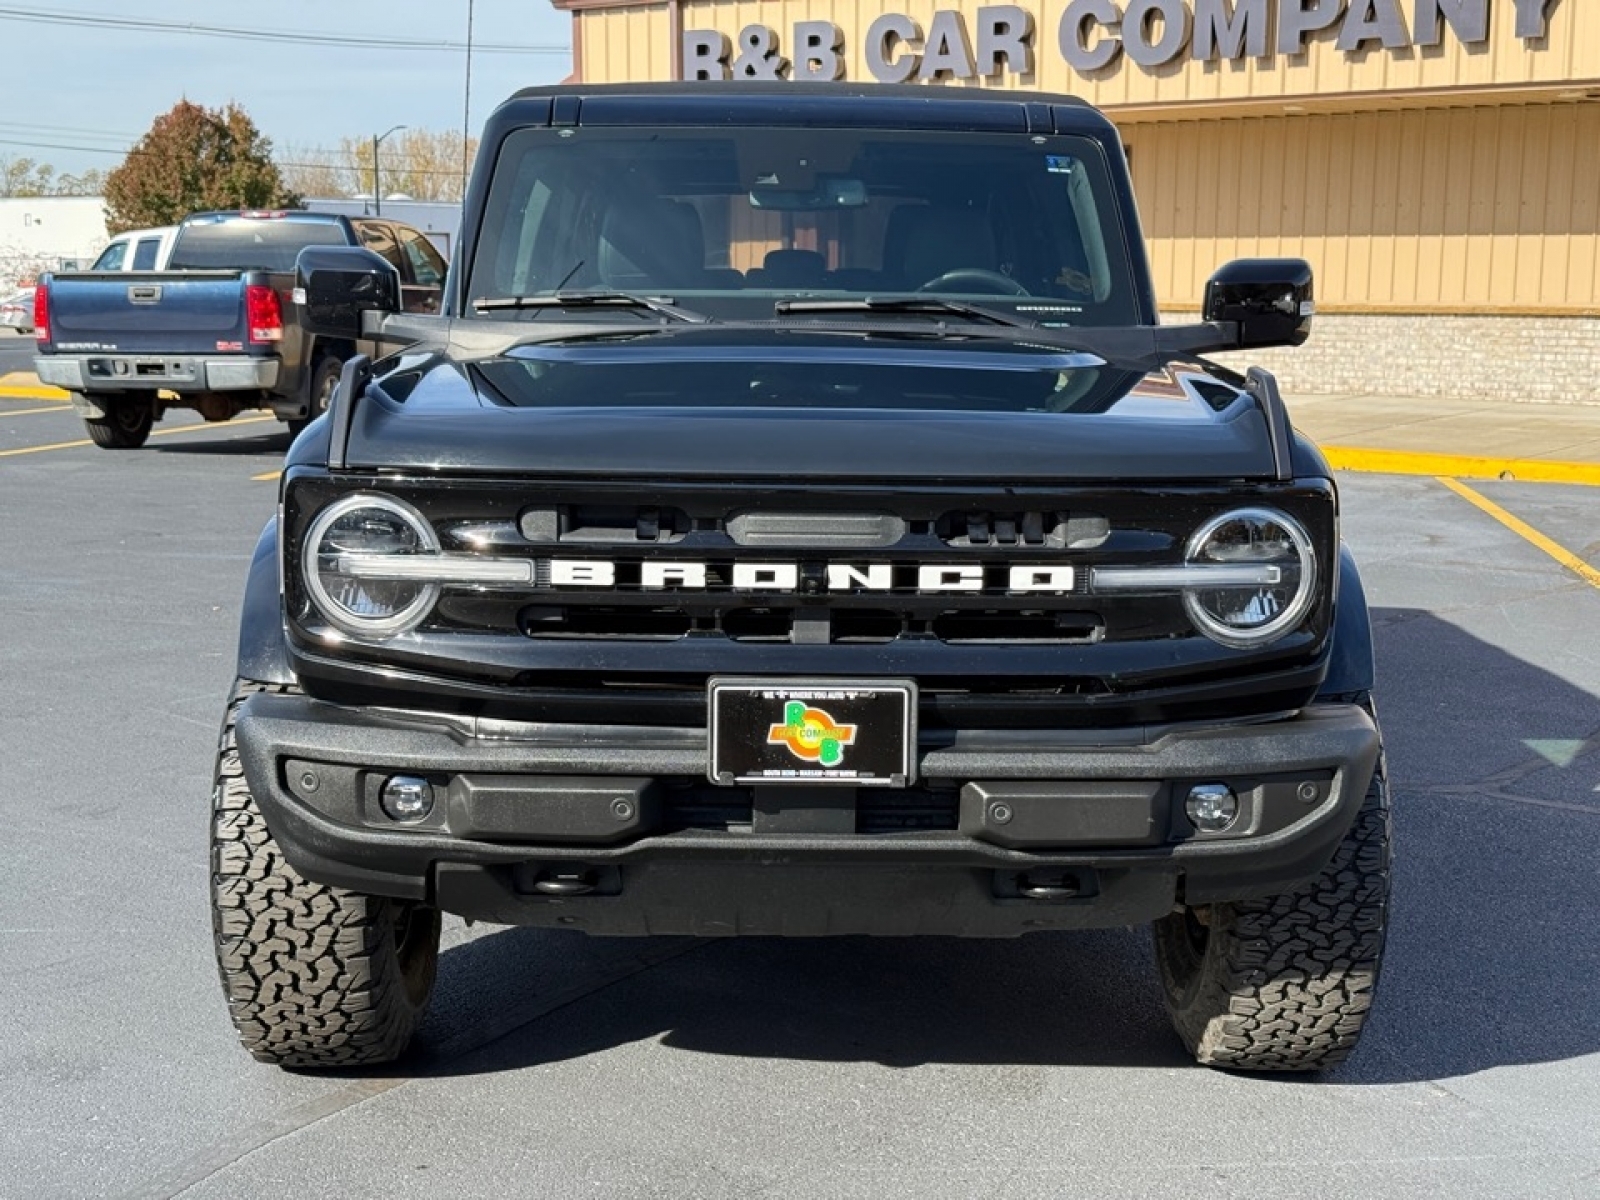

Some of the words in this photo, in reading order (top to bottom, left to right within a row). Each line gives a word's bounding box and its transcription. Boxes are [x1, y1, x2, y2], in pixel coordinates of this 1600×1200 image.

[683, 20, 846, 81] R&B
[865, 5, 1035, 84] CAR
[550, 560, 1074, 592] BRONCO
